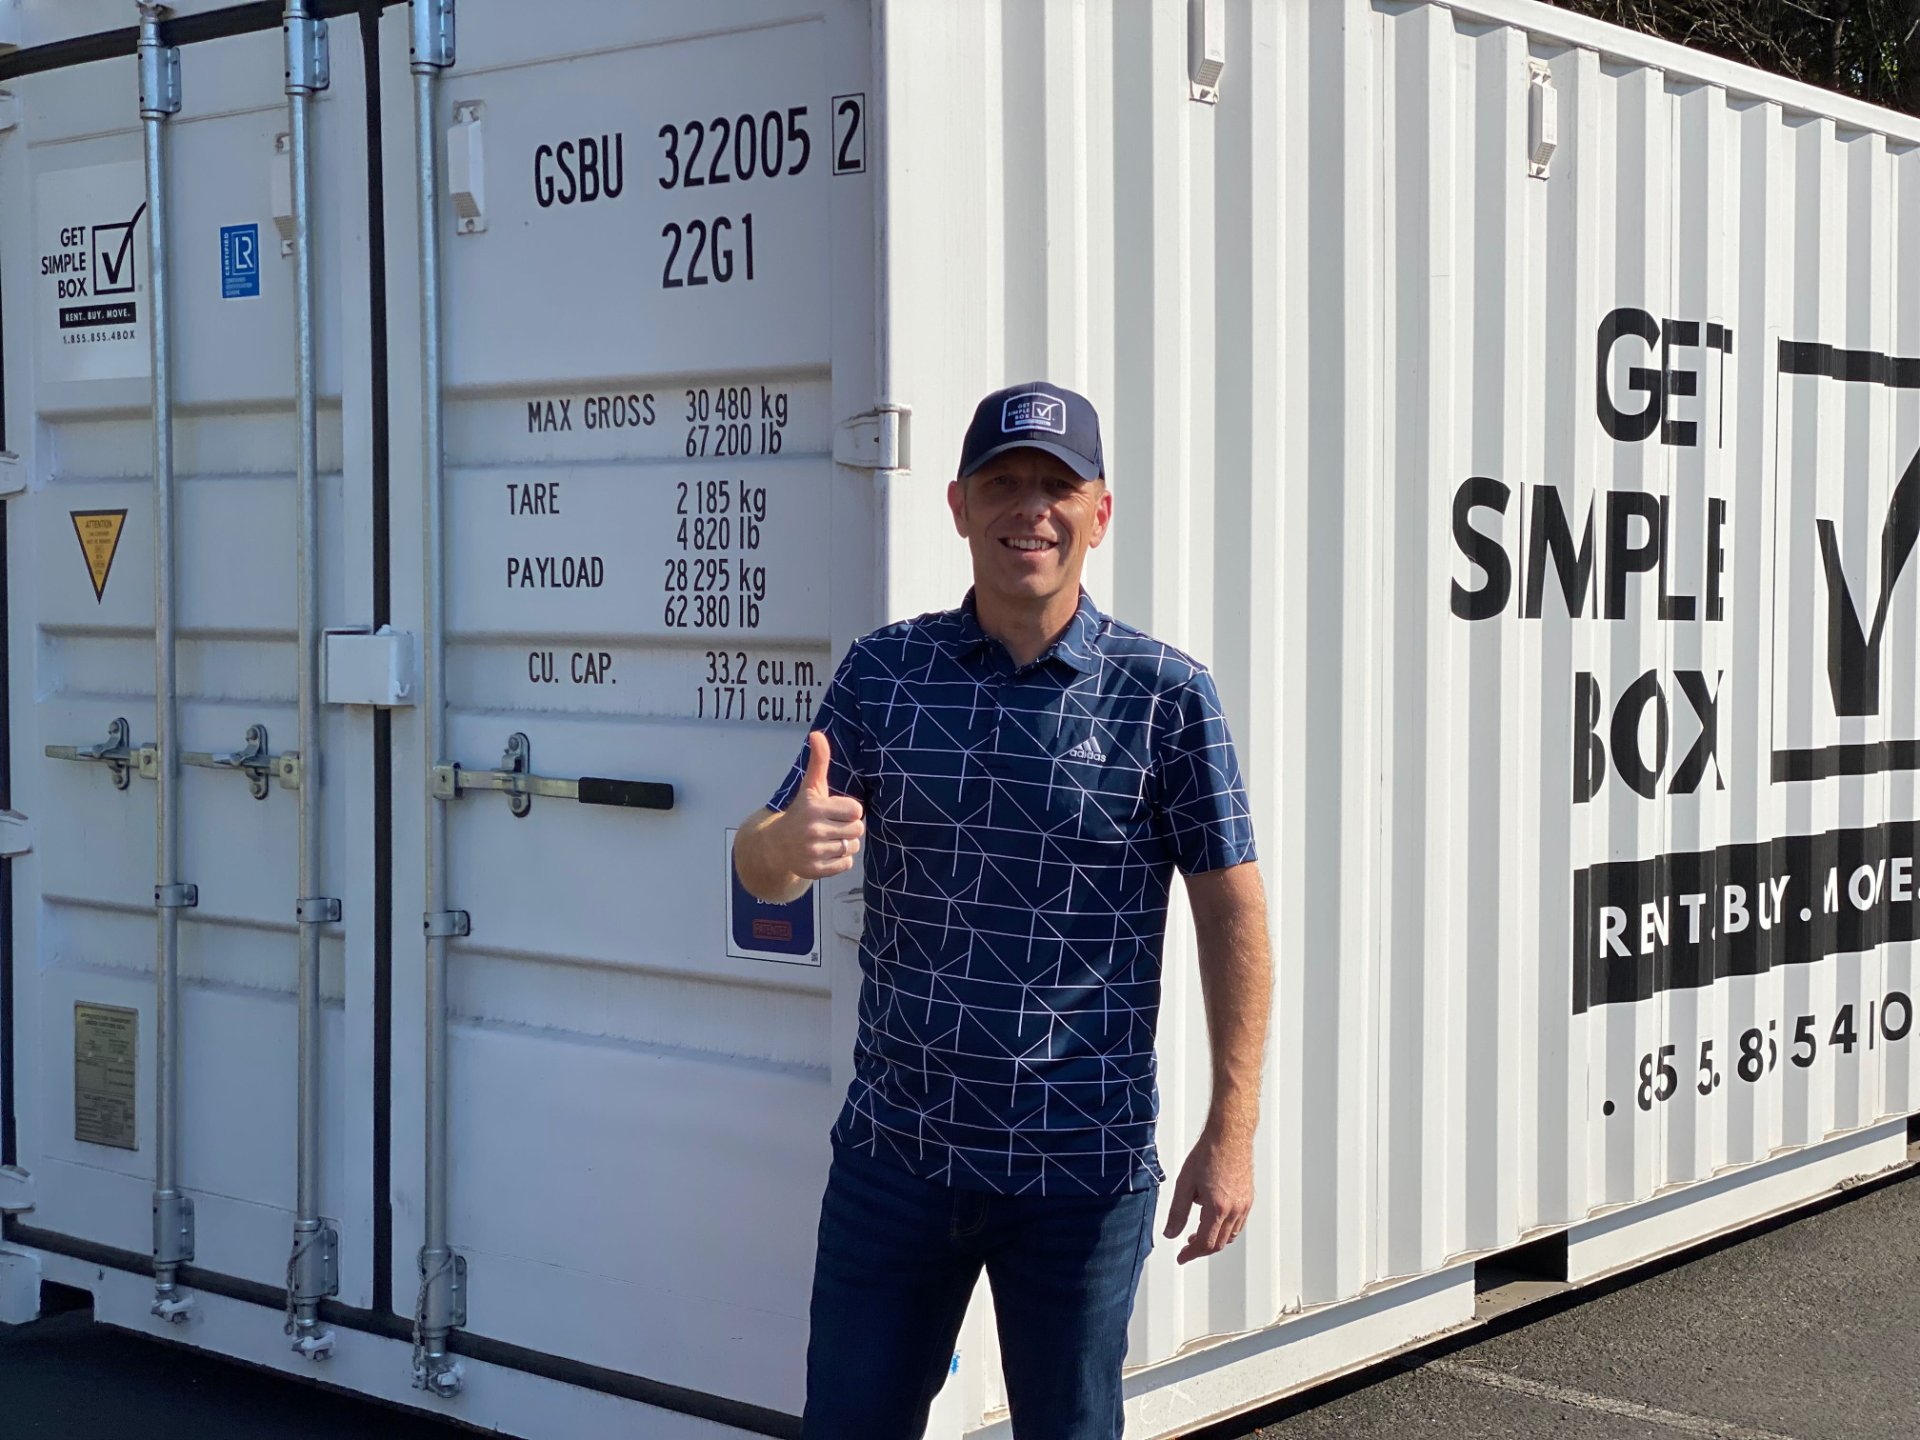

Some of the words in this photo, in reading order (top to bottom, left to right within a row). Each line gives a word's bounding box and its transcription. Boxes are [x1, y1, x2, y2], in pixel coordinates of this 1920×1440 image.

[534, 132, 623, 208] GSBU
[658, 106, 811, 190] 322005
[837, 100, 861, 170] 2
[60, 225, 87, 248] GET
[661, 212, 754, 289] 22G1
[41, 251, 87, 276] SIMPLE
[58, 277, 88, 299] BOX
[65, 313, 86, 322] RENT.
[87, 311, 105, 320] BUY.
[106, 308, 131, 318] MOVE.
[1596, 305, 1735, 450] GET
[527, 399, 572, 433] MAX
[584, 393, 656, 430] GROSS
[760, 385, 788, 429] kg
[760, 421, 784, 456] lb
[506, 482, 560, 516] TARE
[739, 479, 767, 524] kg
[739, 517, 762, 550] lb
[1450, 474, 1727, 622] SIMPLE
[507, 556, 604, 588] PAYLOAD
[739, 558, 766, 602] kg
[739, 597, 762, 629] lb
[528, 651, 559, 684] CU.
[571, 652, 616, 685] CAP.
[705, 650, 748, 685] 33.2
[757, 659, 822, 687] cu.m.
[1572, 668, 1726, 805] BOX
[1070, 750, 1106, 762] adidas
